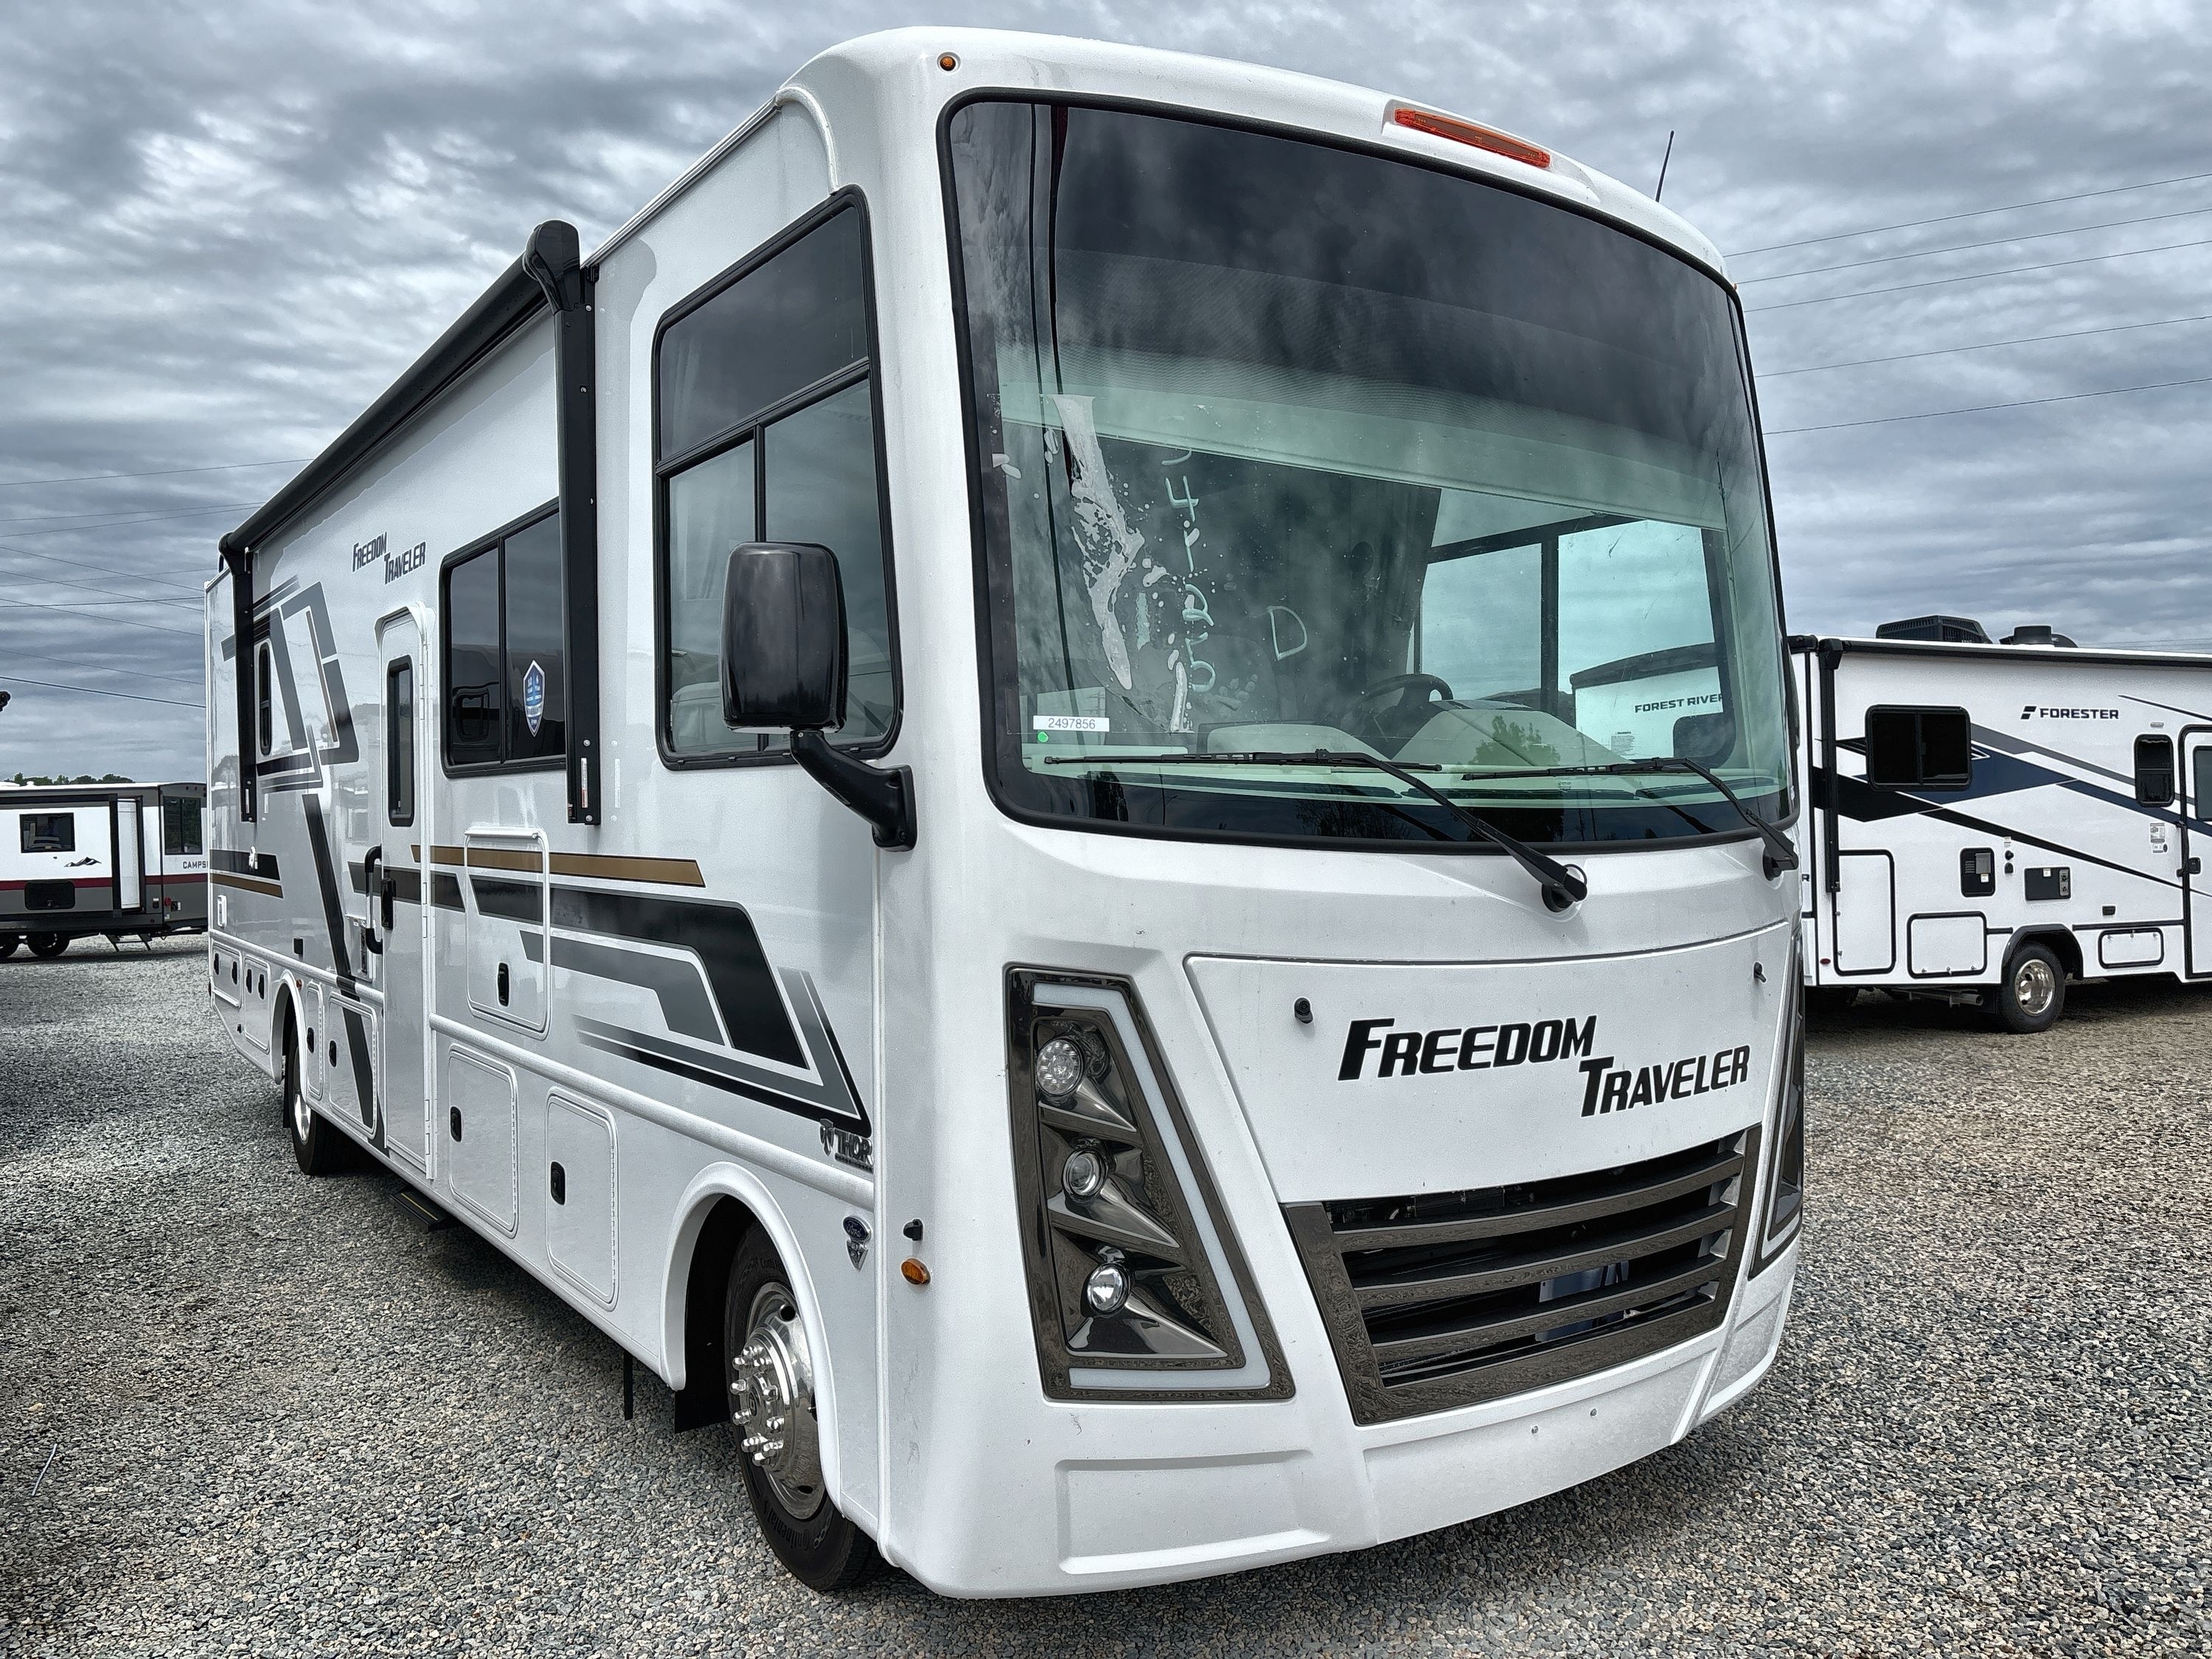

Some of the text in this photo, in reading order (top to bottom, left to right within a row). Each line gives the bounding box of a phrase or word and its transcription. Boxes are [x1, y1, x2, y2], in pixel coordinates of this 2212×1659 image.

[352, 531, 387, 572] FREEDOM
[384, 541, 426, 585] TRAVELER
[1048, 717, 1096, 729] 2497856
[1635, 698, 1685, 713] FOREST
[2039, 708, 2119, 720] FORESTER
[183, 860, 208, 869] CAMPS
[1337, 1015, 1598, 1081] FREEDOM
[1579, 1045, 1750, 1118] TRAVELER
[834, 1127, 874, 1166] THOR
